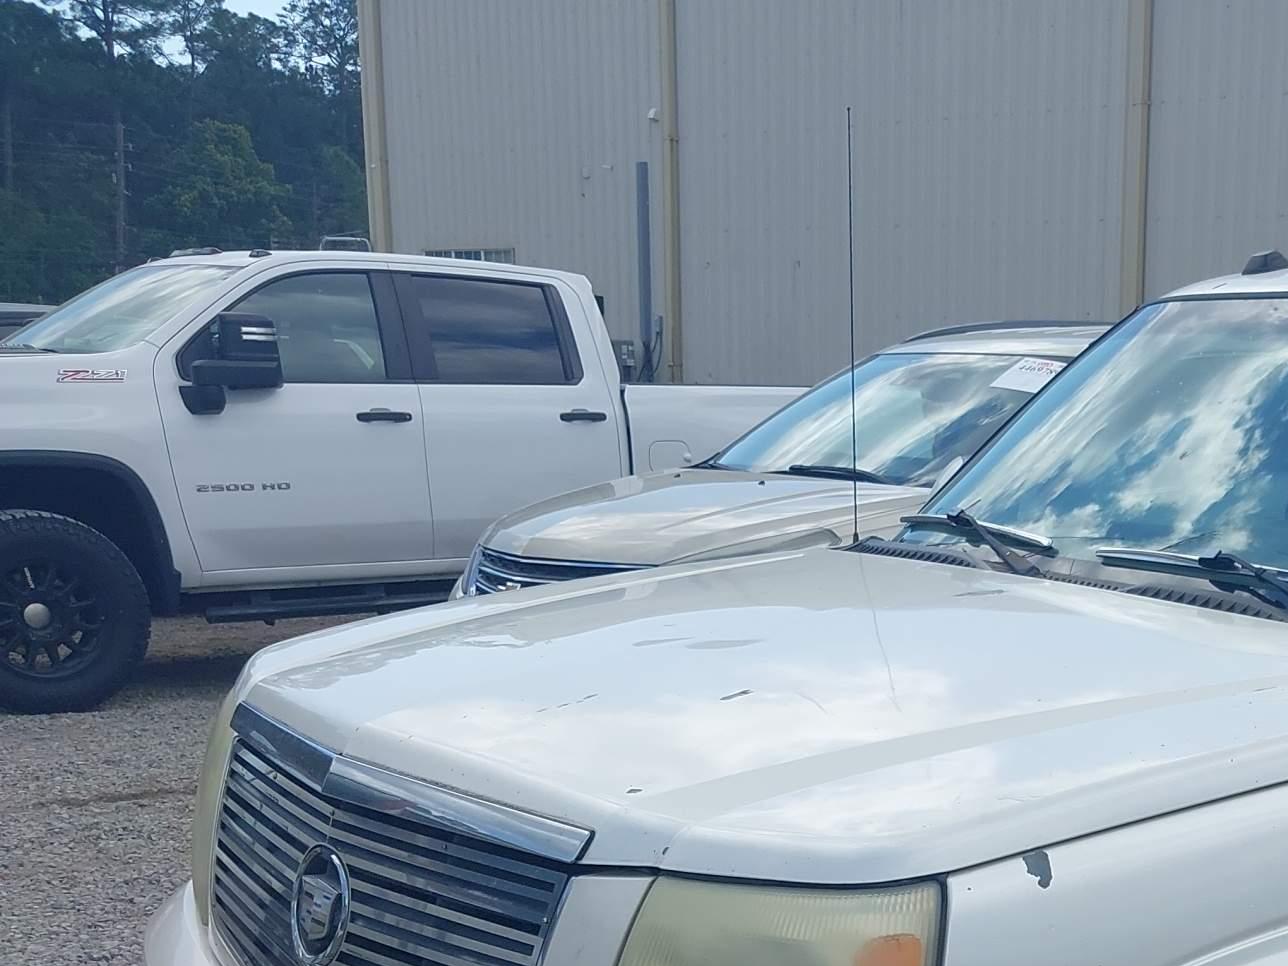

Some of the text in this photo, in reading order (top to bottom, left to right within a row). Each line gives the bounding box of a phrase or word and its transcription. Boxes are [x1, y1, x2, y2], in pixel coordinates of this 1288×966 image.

[57, 369, 128, 384] Z71
[196, 481, 292, 493] 2500 HD
